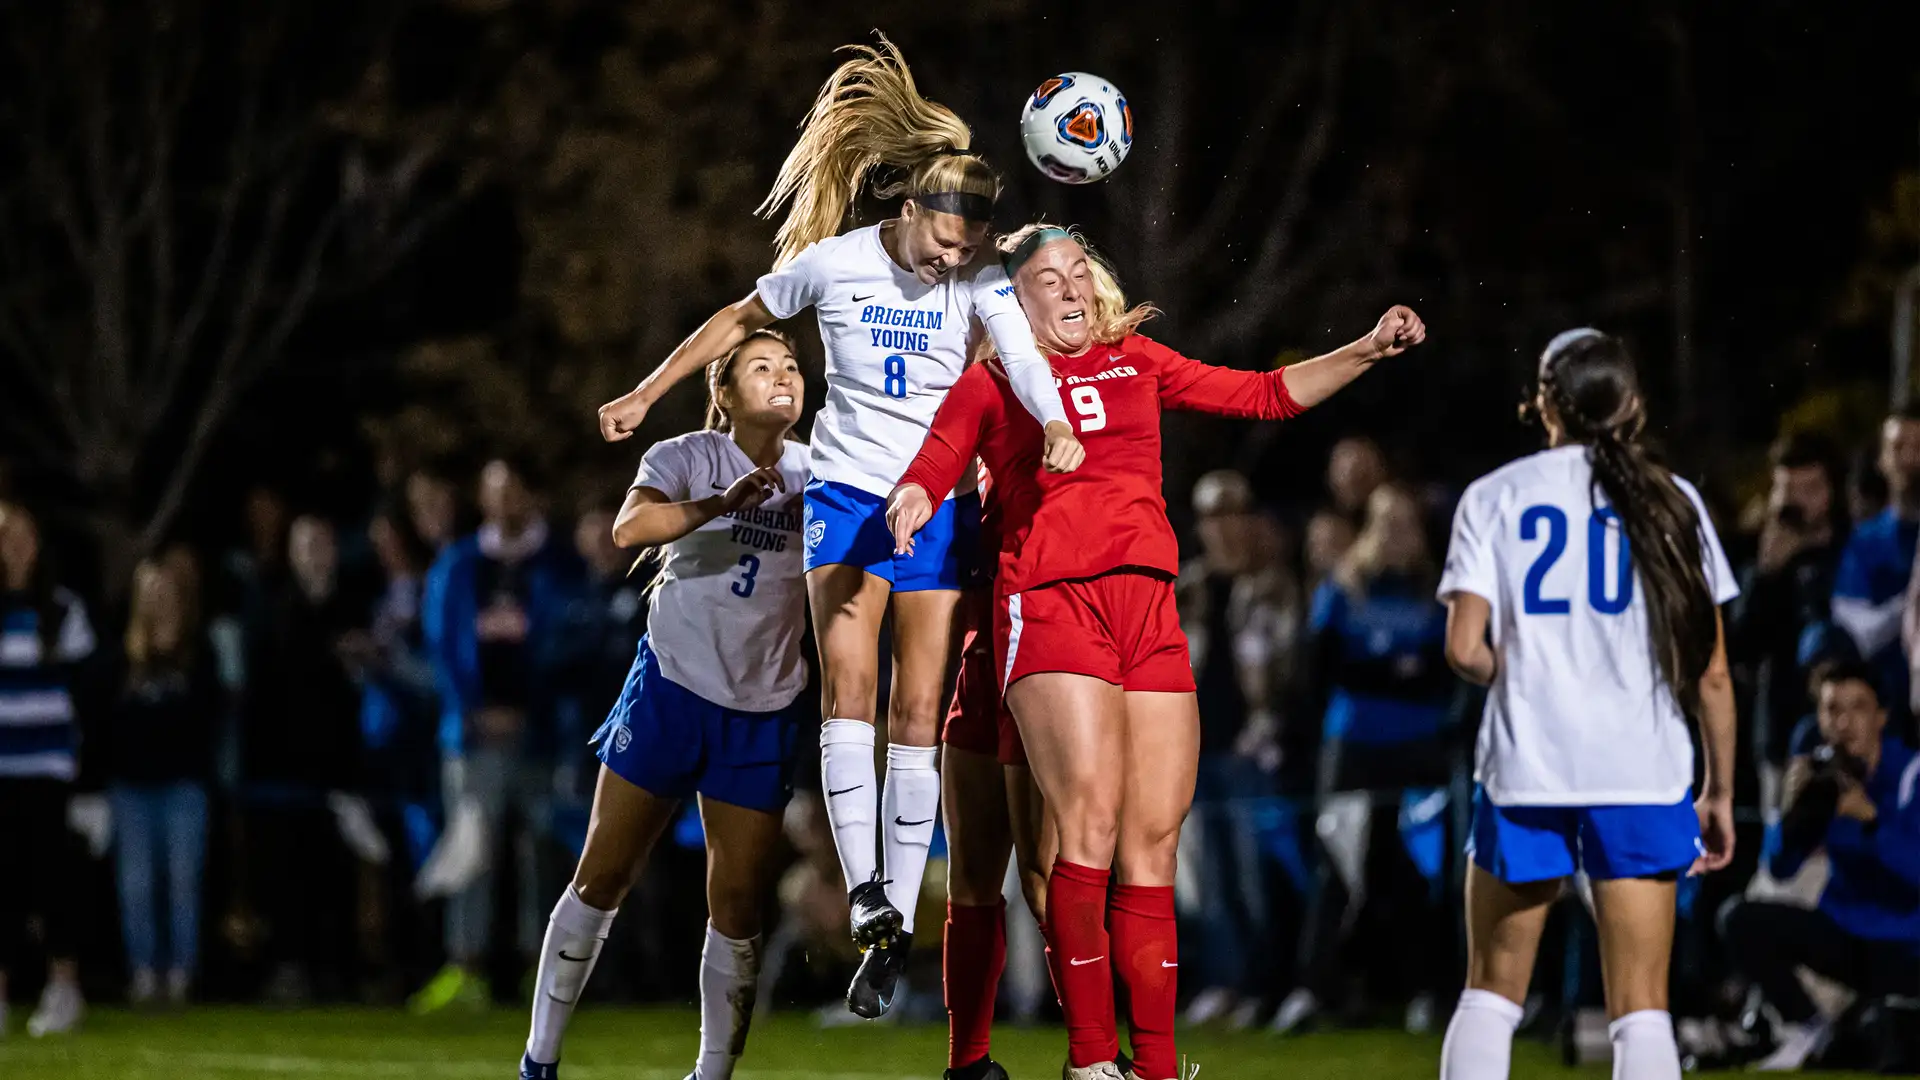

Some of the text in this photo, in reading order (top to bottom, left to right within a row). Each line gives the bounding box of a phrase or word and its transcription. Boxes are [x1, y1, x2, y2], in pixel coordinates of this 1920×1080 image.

[860, 304, 943, 330] BRIGHAM
[870, 328, 929, 352] YOUNG
[884, 355, 907, 399] 8
[1070, 385, 1107, 433] 9
[730, 524, 788, 552] YOUNG
[1520, 504, 1634, 615] 20
[731, 554, 761, 598] 3
